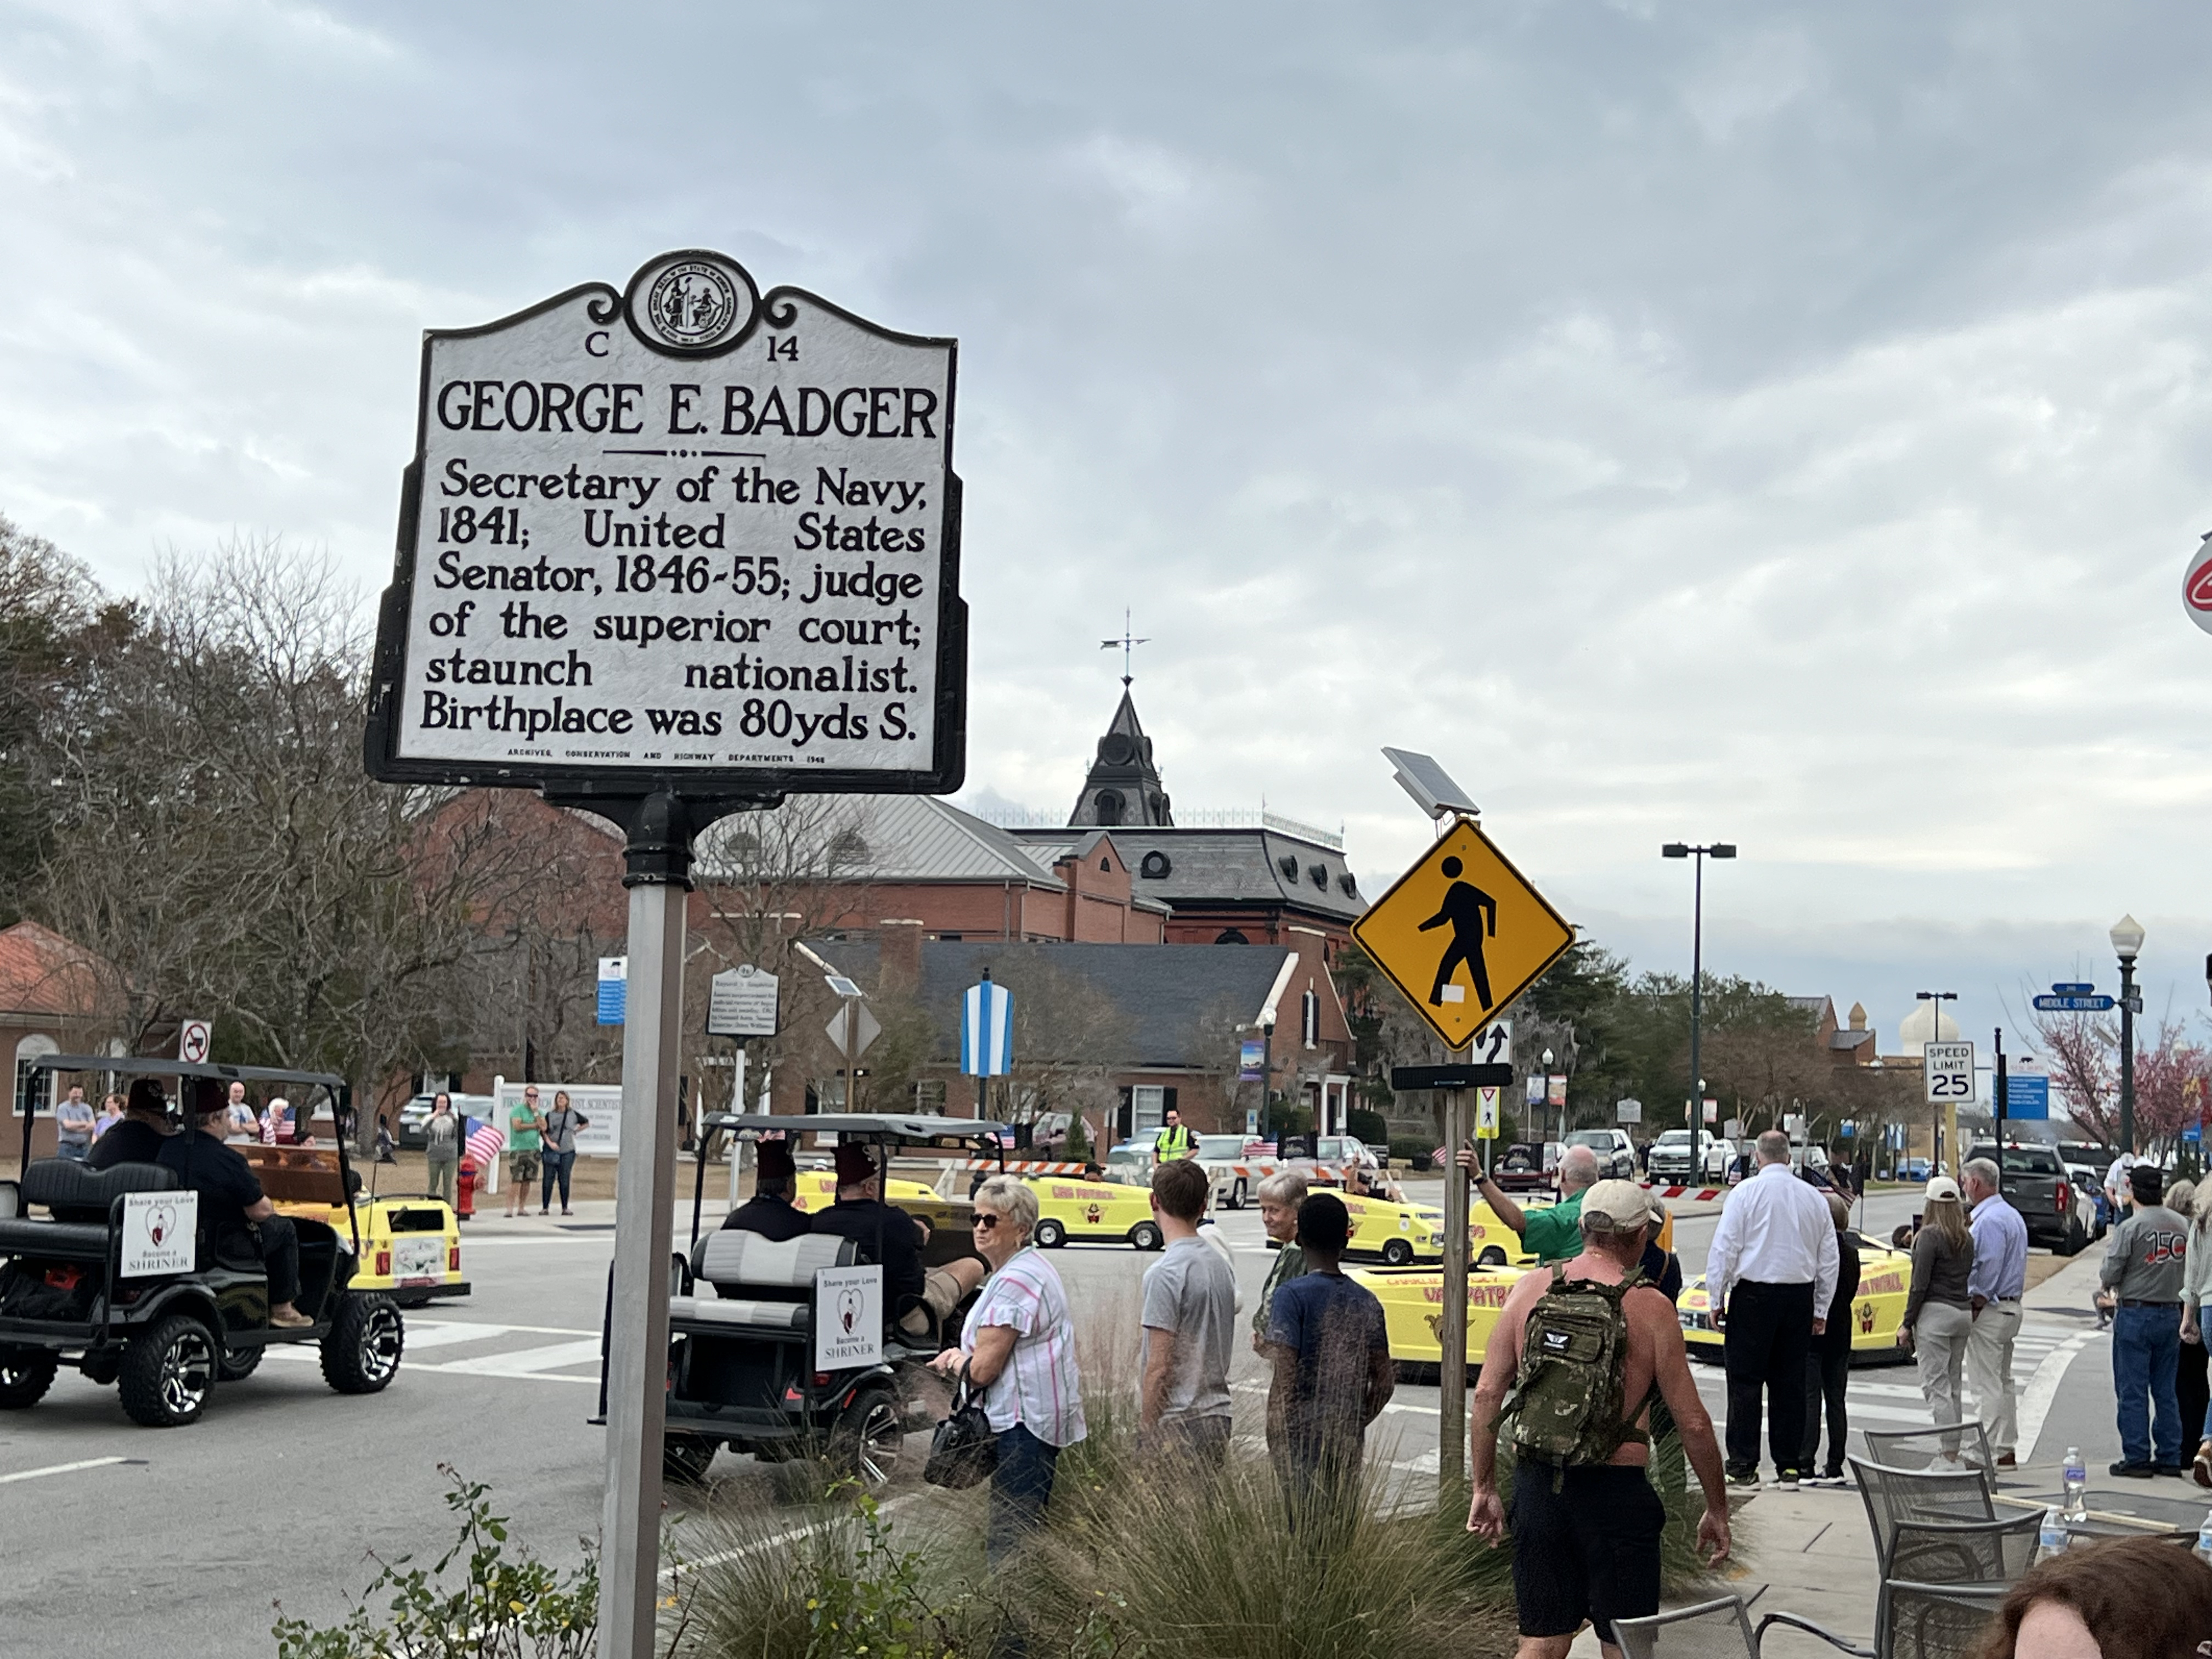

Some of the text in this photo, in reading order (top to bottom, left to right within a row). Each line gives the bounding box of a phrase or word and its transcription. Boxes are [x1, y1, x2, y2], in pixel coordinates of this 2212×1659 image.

[585, 331, 610, 357] C
[767, 335, 799, 362] 14
[437, 380, 938, 439] GEORGE E. BADGER
[441, 458, 926, 514] Secretary of the Navy,
[437, 506, 925, 553] 1841; United States
[433, 551, 923, 606] Senator, 1846-55; judge
[429, 601, 921, 650] of the superior court;
[425, 648, 917, 693] staunch nationalist.
[420, 690, 916, 748] Birthplace was 80yds S.
[728, 754, 794, 763] DEPARTMENTS
[2039, 997, 2104, 1008] MIDDLE STREET
[1929, 1047, 1969, 1058] SPEED
[1933, 1060, 1965, 1071] LIMIT
[1932, 1074, 1969, 1096] 25
[128, 1257, 188, 1271] SHRINER
[845, 1279, 860, 1288] your
[824, 1344, 874, 1359] SHRINER
